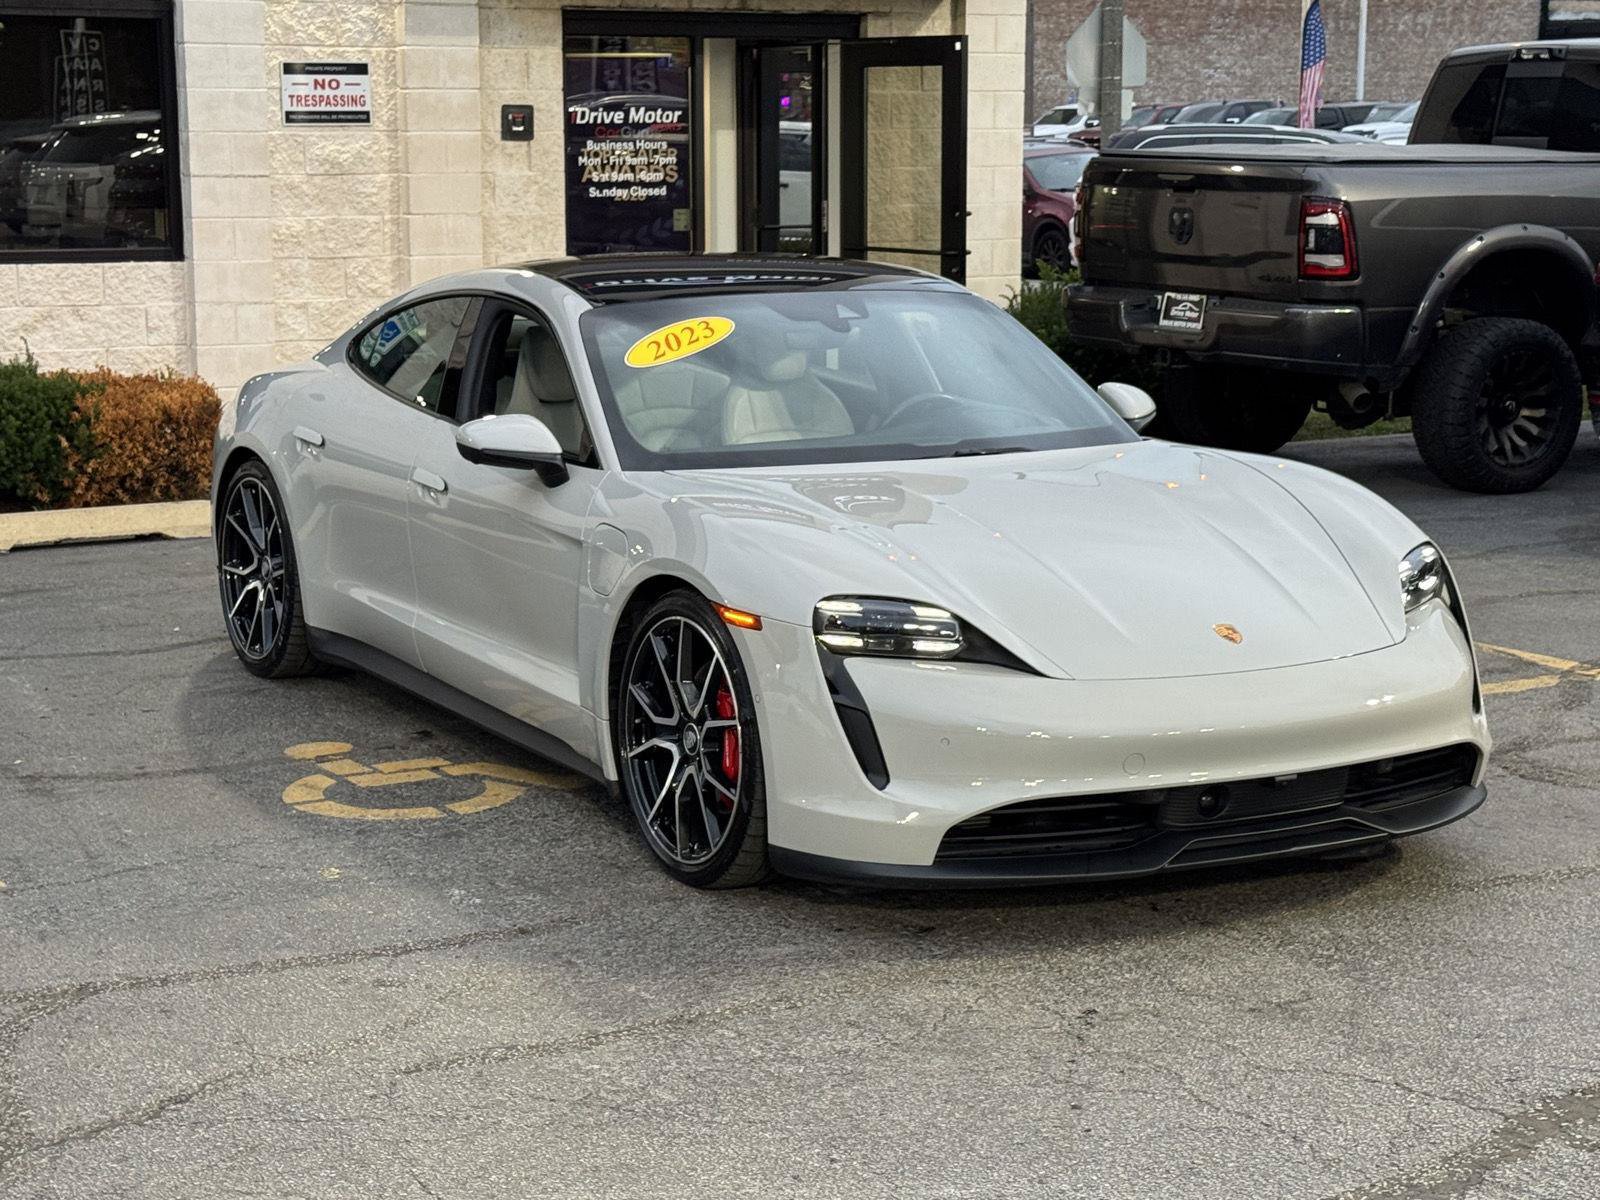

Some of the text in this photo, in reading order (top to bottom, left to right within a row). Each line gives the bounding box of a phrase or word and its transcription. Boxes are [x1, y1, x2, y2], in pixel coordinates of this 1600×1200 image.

[313, 78, 341, 91] NO
[287, 94, 367, 108] TRESPASSING
[628, 106, 683, 124] Motor
[586, 140, 668, 150] Business Hours
[578, 156, 602, 167] Mon
[625, 155, 648, 166] 9am
[588, 185, 668, 199] Sunday Closed
[646, 320, 716, 361] 2023
